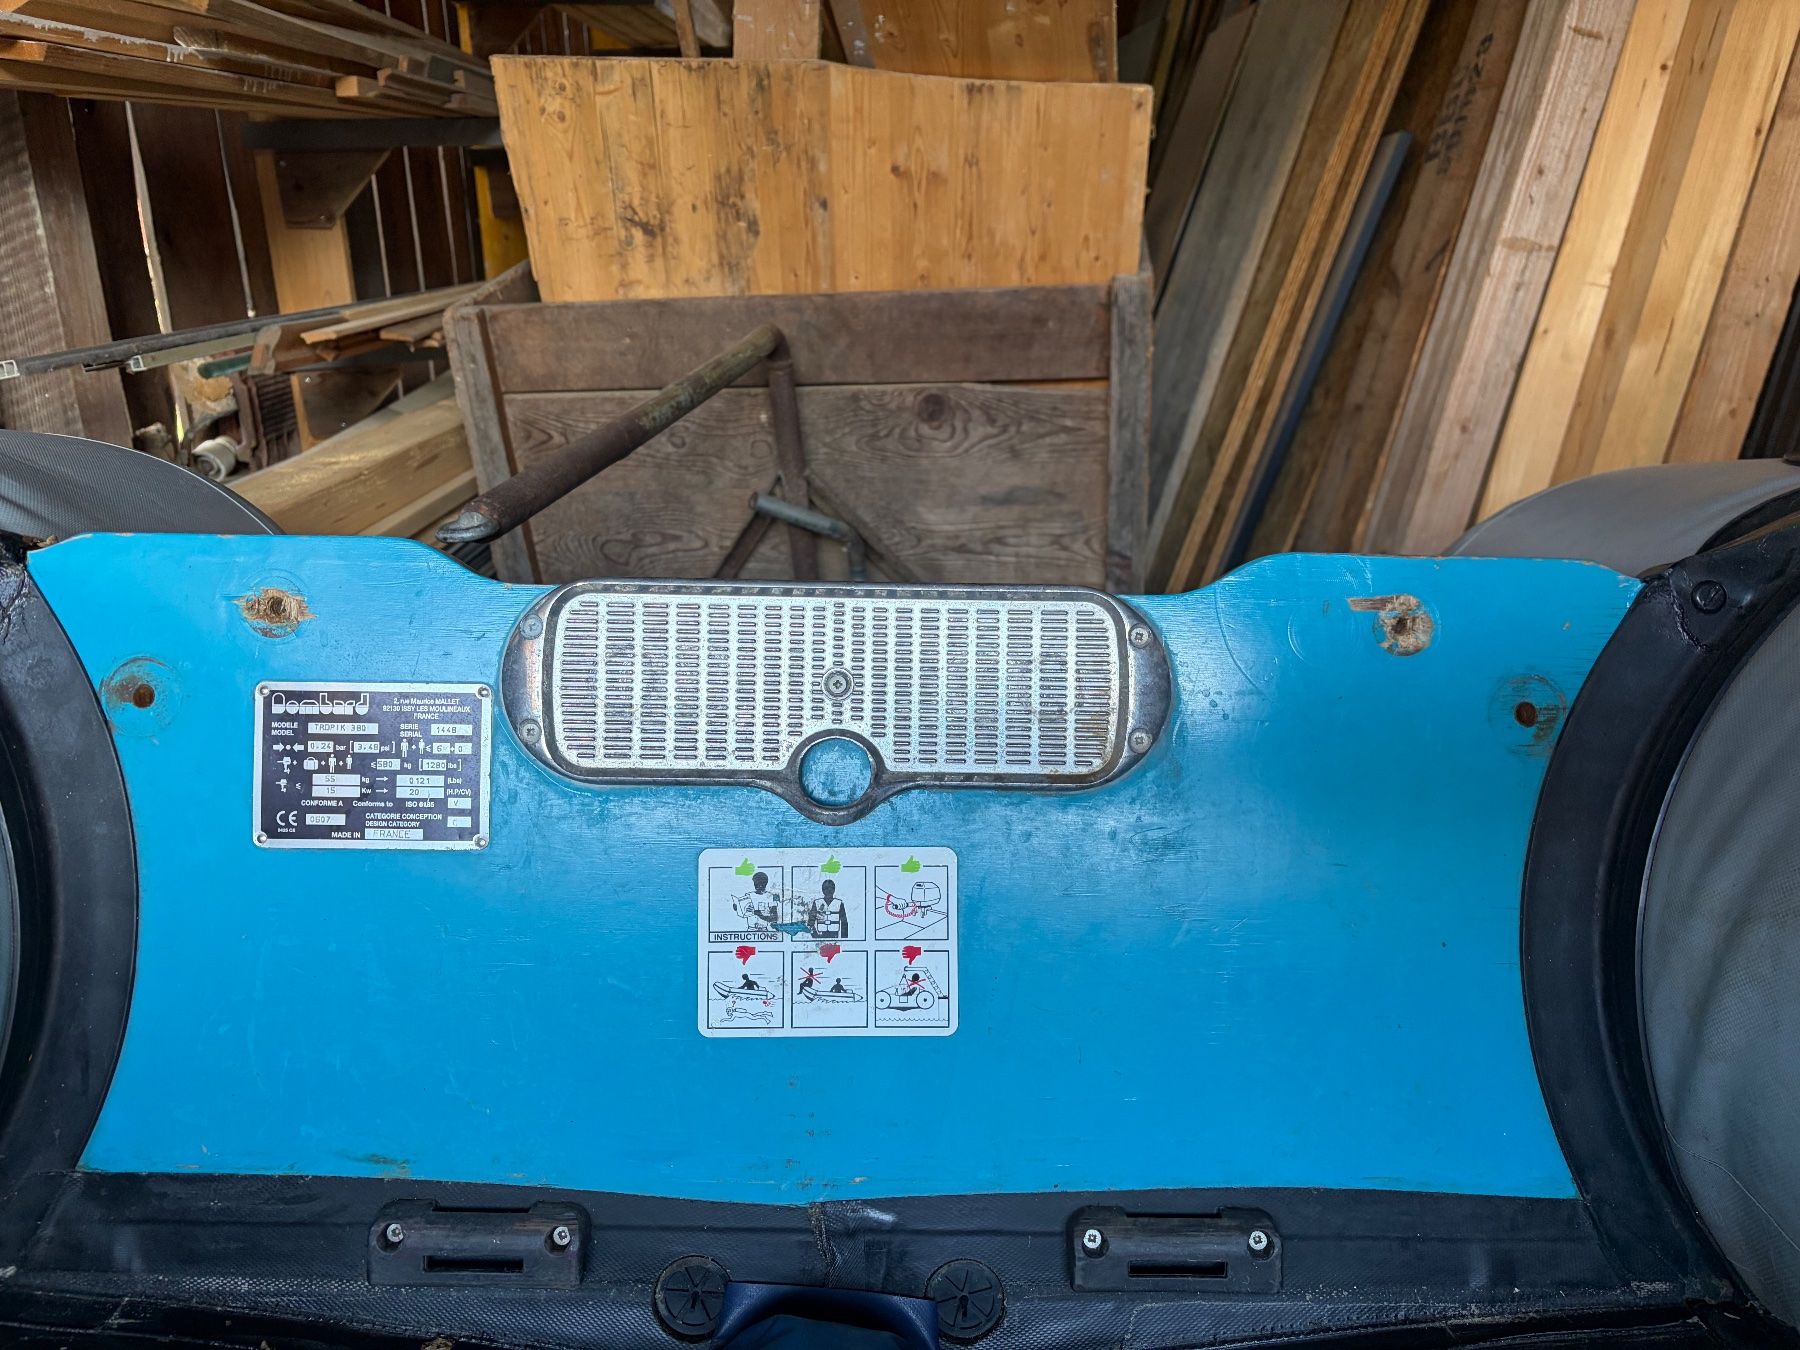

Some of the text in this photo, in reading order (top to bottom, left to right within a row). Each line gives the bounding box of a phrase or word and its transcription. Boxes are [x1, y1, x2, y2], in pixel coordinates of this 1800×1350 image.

[435, 698, 460, 706] MALLET
[401, 705, 416, 713] ISSY
[271, 721, 299, 729] MODELE
[403, 762, 412, 770] kg
[324, 775, 336, 783] 55
[409, 788, 420, 796] 20
[300, 799, 338, 807] CONFORME
[276, 810, 298, 826] CE
[365, 812, 401, 820] CATEGORIE
[331, 831, 353, 839] MADE
[372, 830, 411, 839] FRANCE
[713, 932, 778, 941] INSTRUCTIONS
